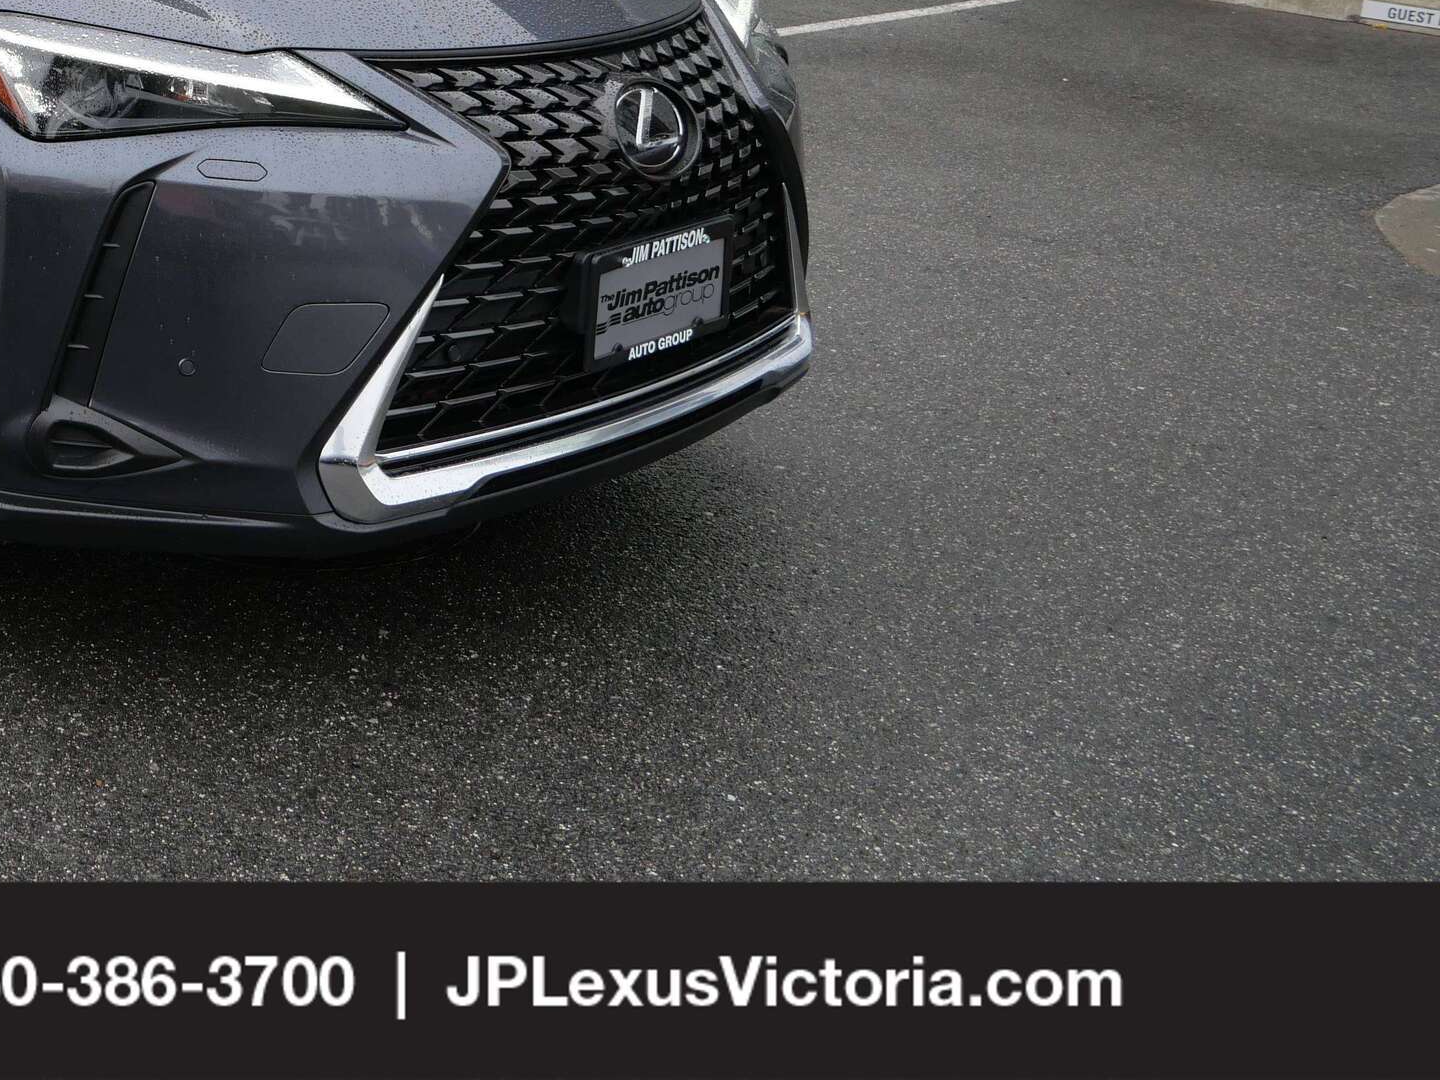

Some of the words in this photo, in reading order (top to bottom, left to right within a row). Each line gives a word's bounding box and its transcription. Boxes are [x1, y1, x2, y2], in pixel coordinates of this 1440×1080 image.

[1387, 7, 1436, 24] GUEST
[631, 243, 650, 266] JIM
[651, 228, 705, 258] PATTISON
[601, 293, 615, 304] The
[628, 341, 656, 361] AUTO
[658, 328, 693, 350] GROUP
